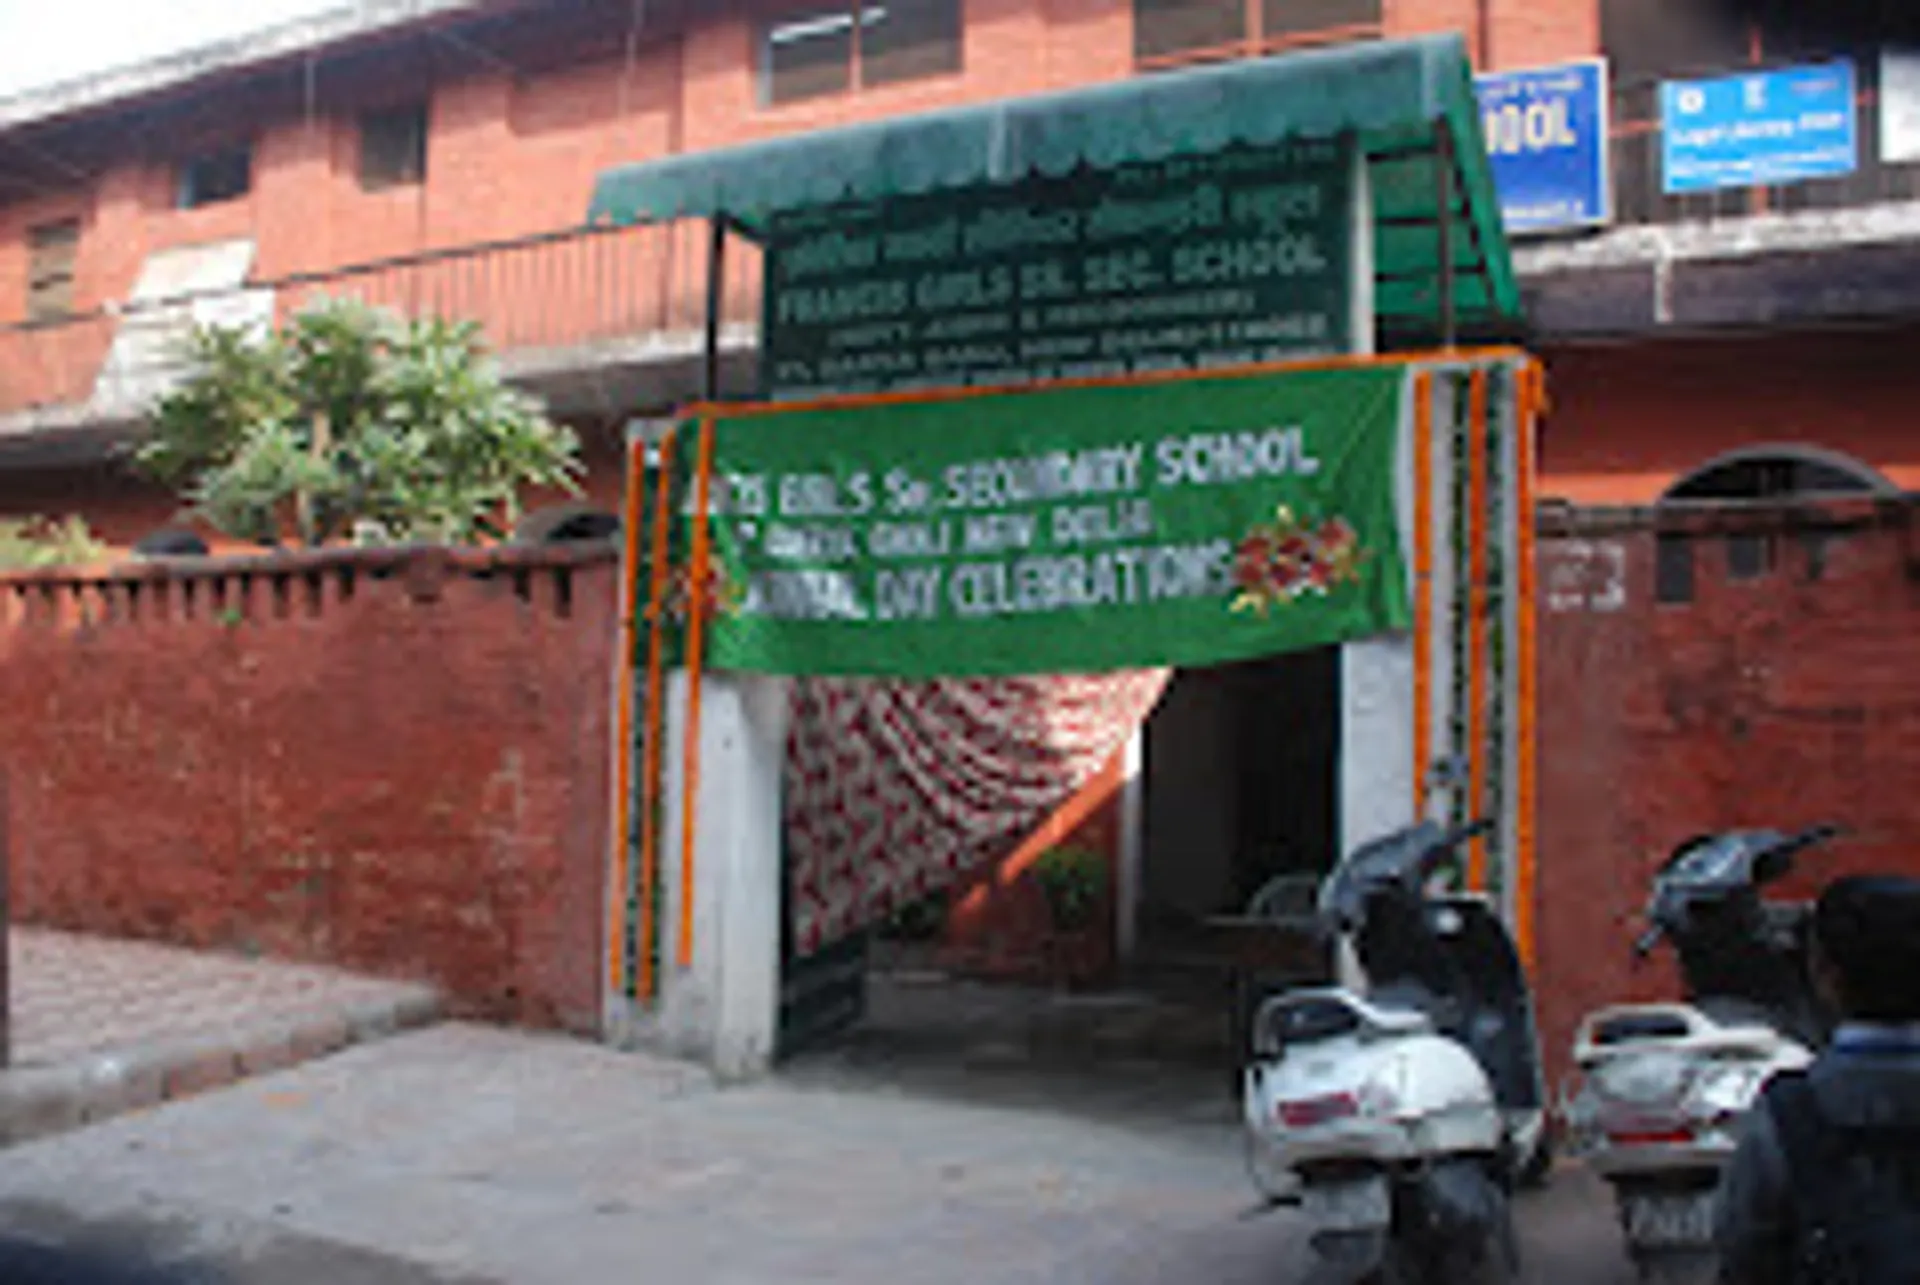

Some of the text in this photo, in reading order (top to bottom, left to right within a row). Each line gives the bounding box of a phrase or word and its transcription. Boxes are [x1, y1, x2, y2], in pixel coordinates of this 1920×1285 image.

[1172, 233, 1328, 283] SCHOOL
[1156, 426, 1320, 486] SCHOOL
[950, 536, 1233, 618] CELEBRATIONS
